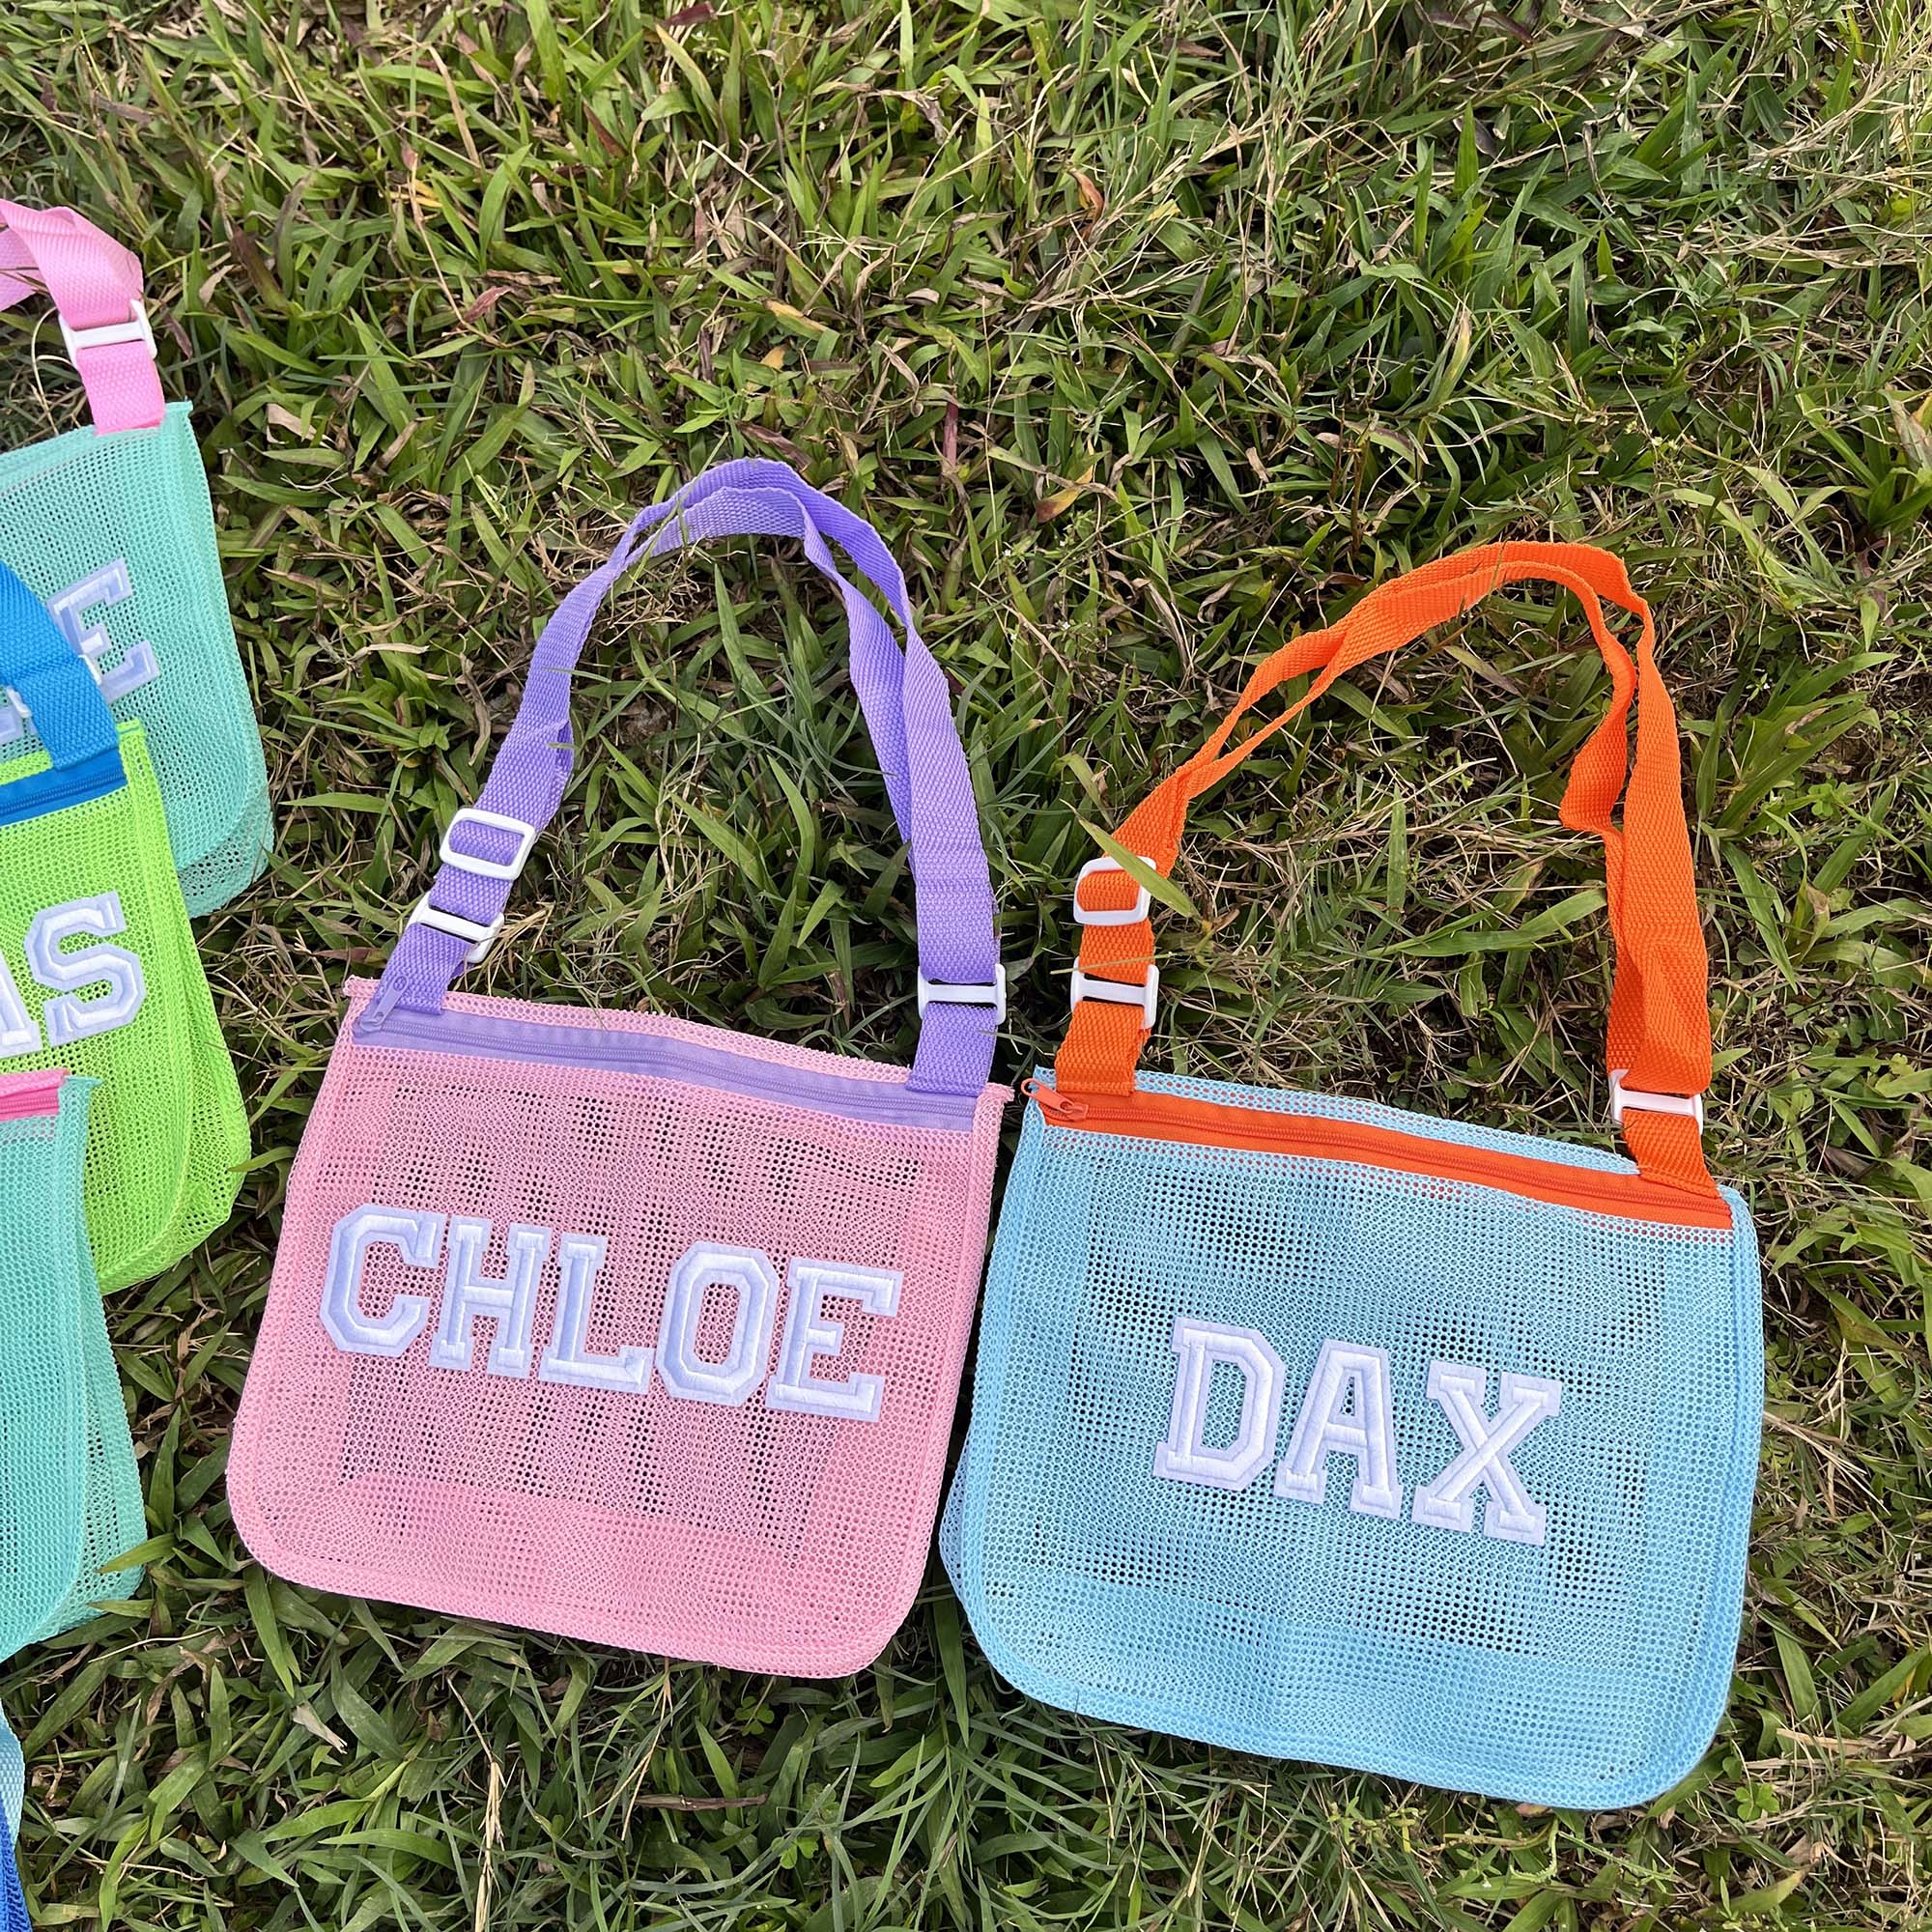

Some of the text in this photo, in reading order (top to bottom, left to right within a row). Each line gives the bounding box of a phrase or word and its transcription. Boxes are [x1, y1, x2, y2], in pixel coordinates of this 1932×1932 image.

[0, 890, 147, 1059] S
[319, 1204, 904, 1422] CHLOE
[1152, 1316, 1562, 1547] DAX
